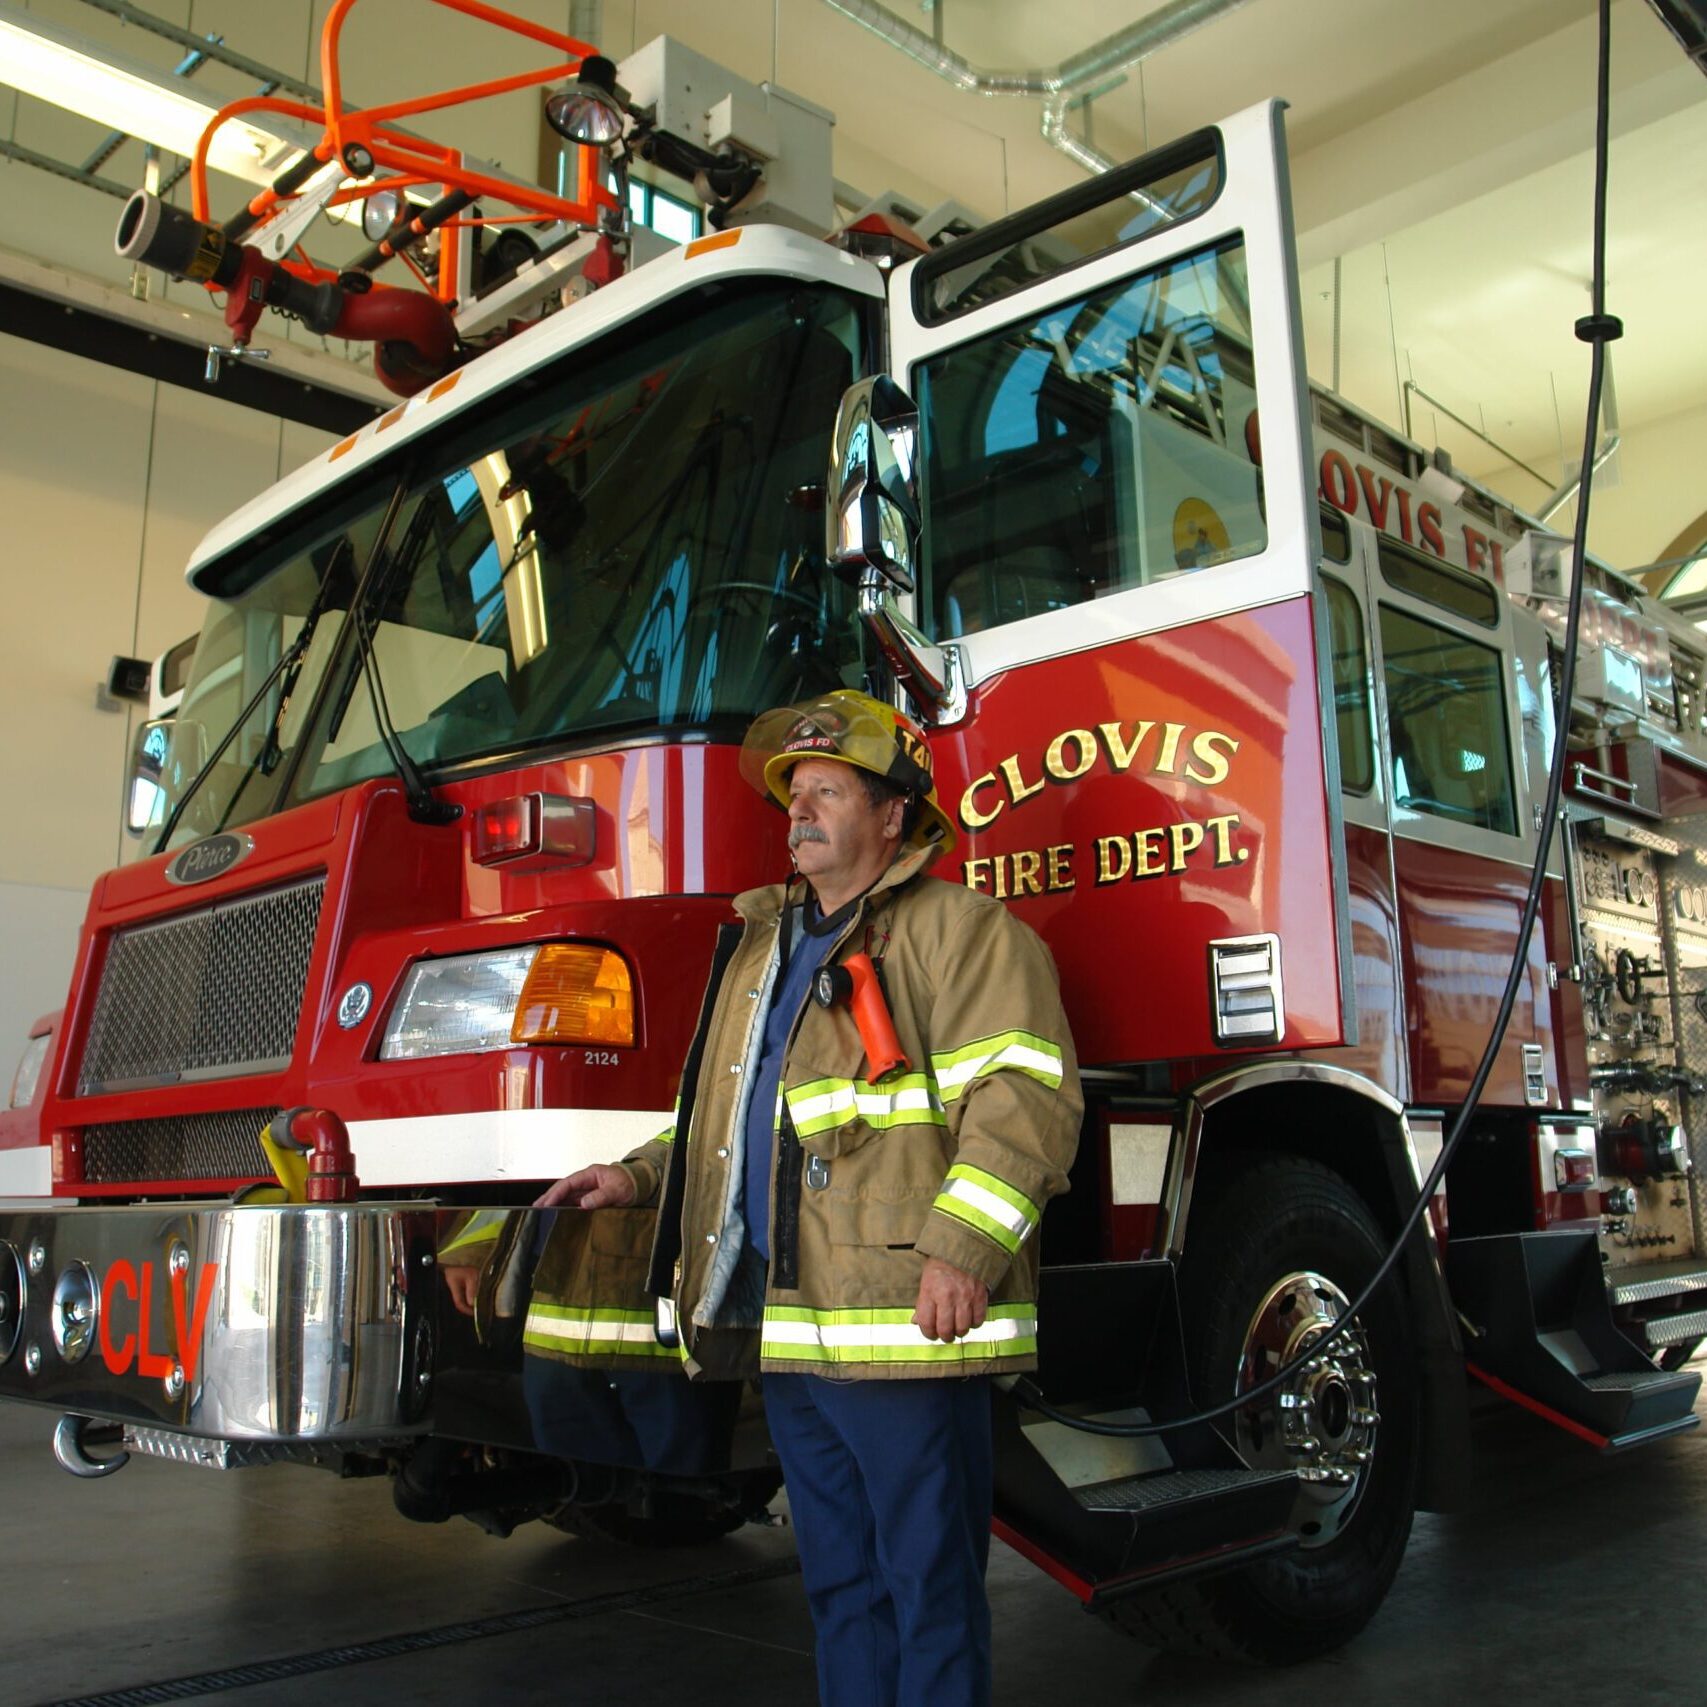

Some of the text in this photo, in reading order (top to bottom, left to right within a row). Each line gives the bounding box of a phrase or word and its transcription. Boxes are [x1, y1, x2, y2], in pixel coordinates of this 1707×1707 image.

[1462, 524, 1505, 590] FI
[785, 737, 831, 753] CLOVIS FD
[959, 721, 1240, 829] CLOVIS
[963, 814, 1250, 900] FIRE DEPT.
[584, 1051, 619, 1066] 2124
[99, 1258, 219, 1383] CLV
